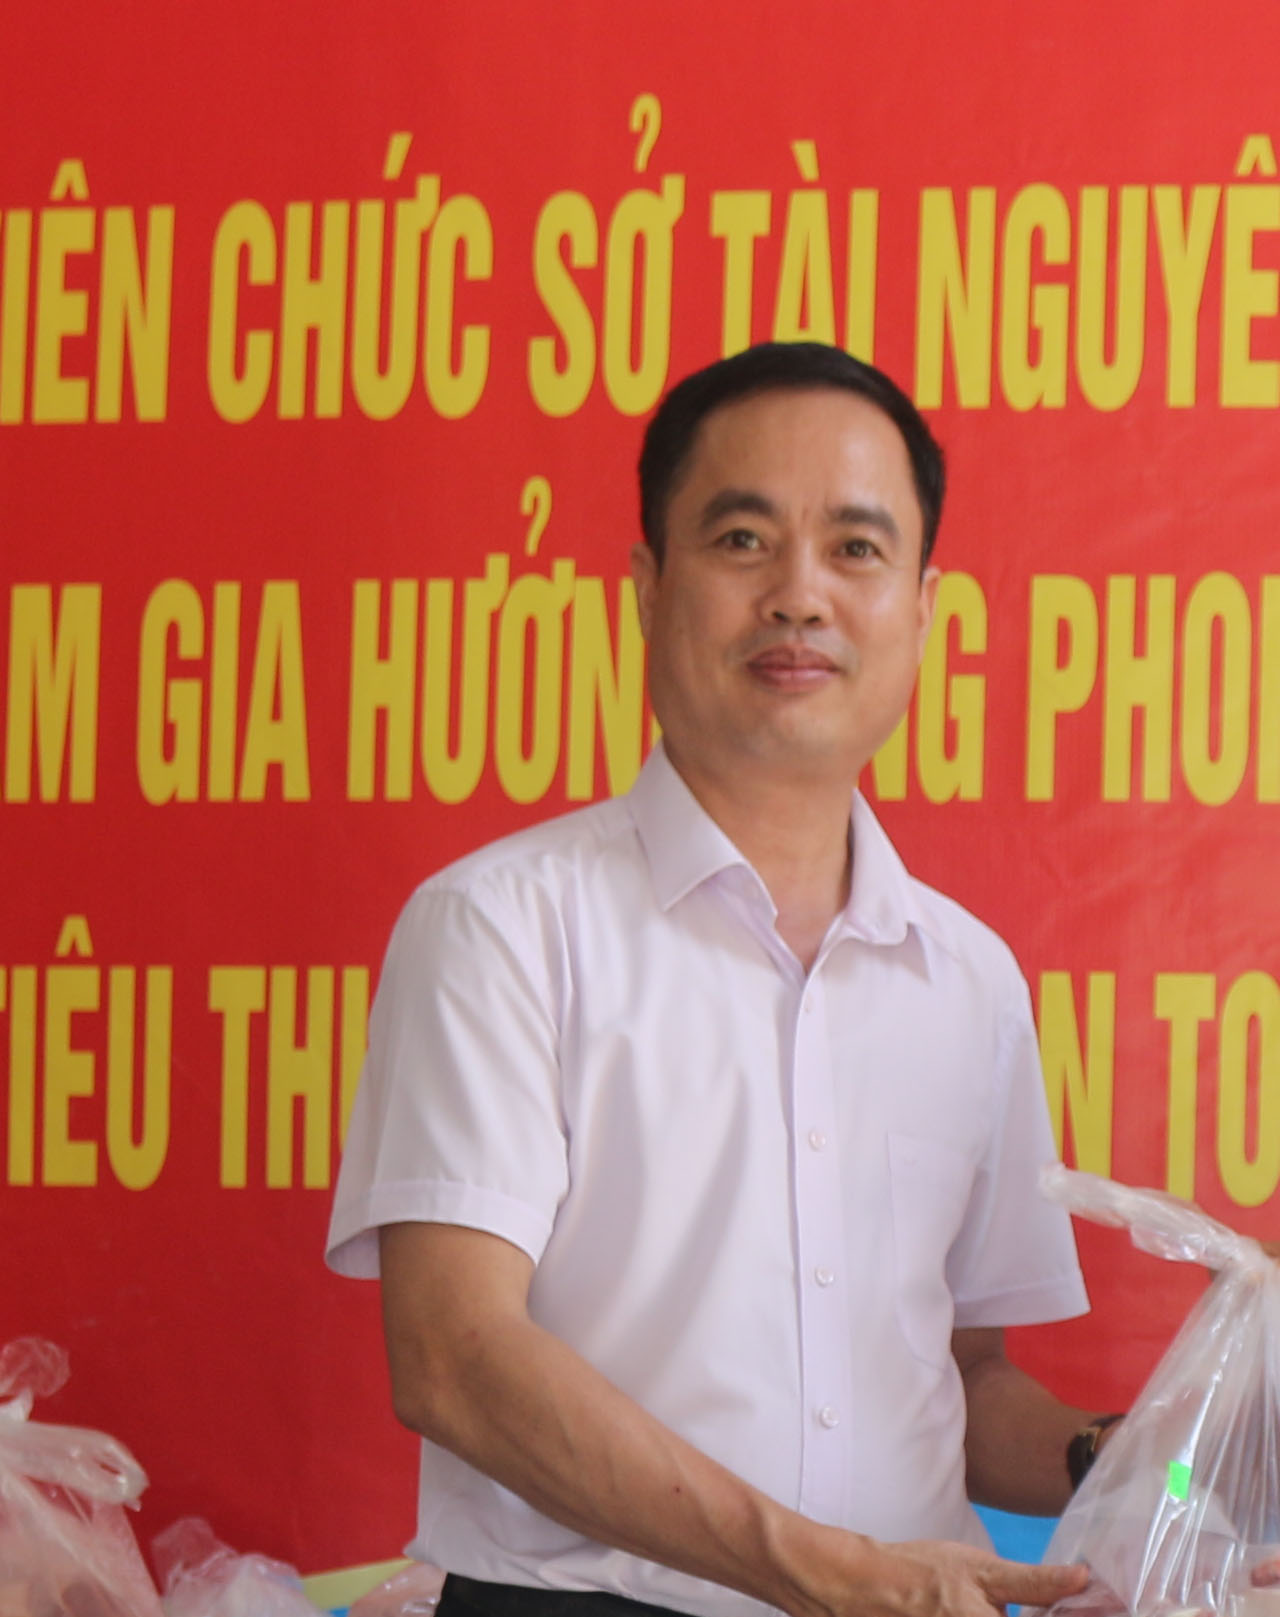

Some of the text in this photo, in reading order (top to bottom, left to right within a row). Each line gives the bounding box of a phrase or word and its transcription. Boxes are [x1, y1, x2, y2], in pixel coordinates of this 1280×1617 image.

[206, 132, 494, 421] CHỨC
[528, 93, 685, 419] SỞ
[710, 140, 880, 368] TÀI
[136, 578, 312, 806] GIA
[346, 475, 654, 804] HƯỞN
